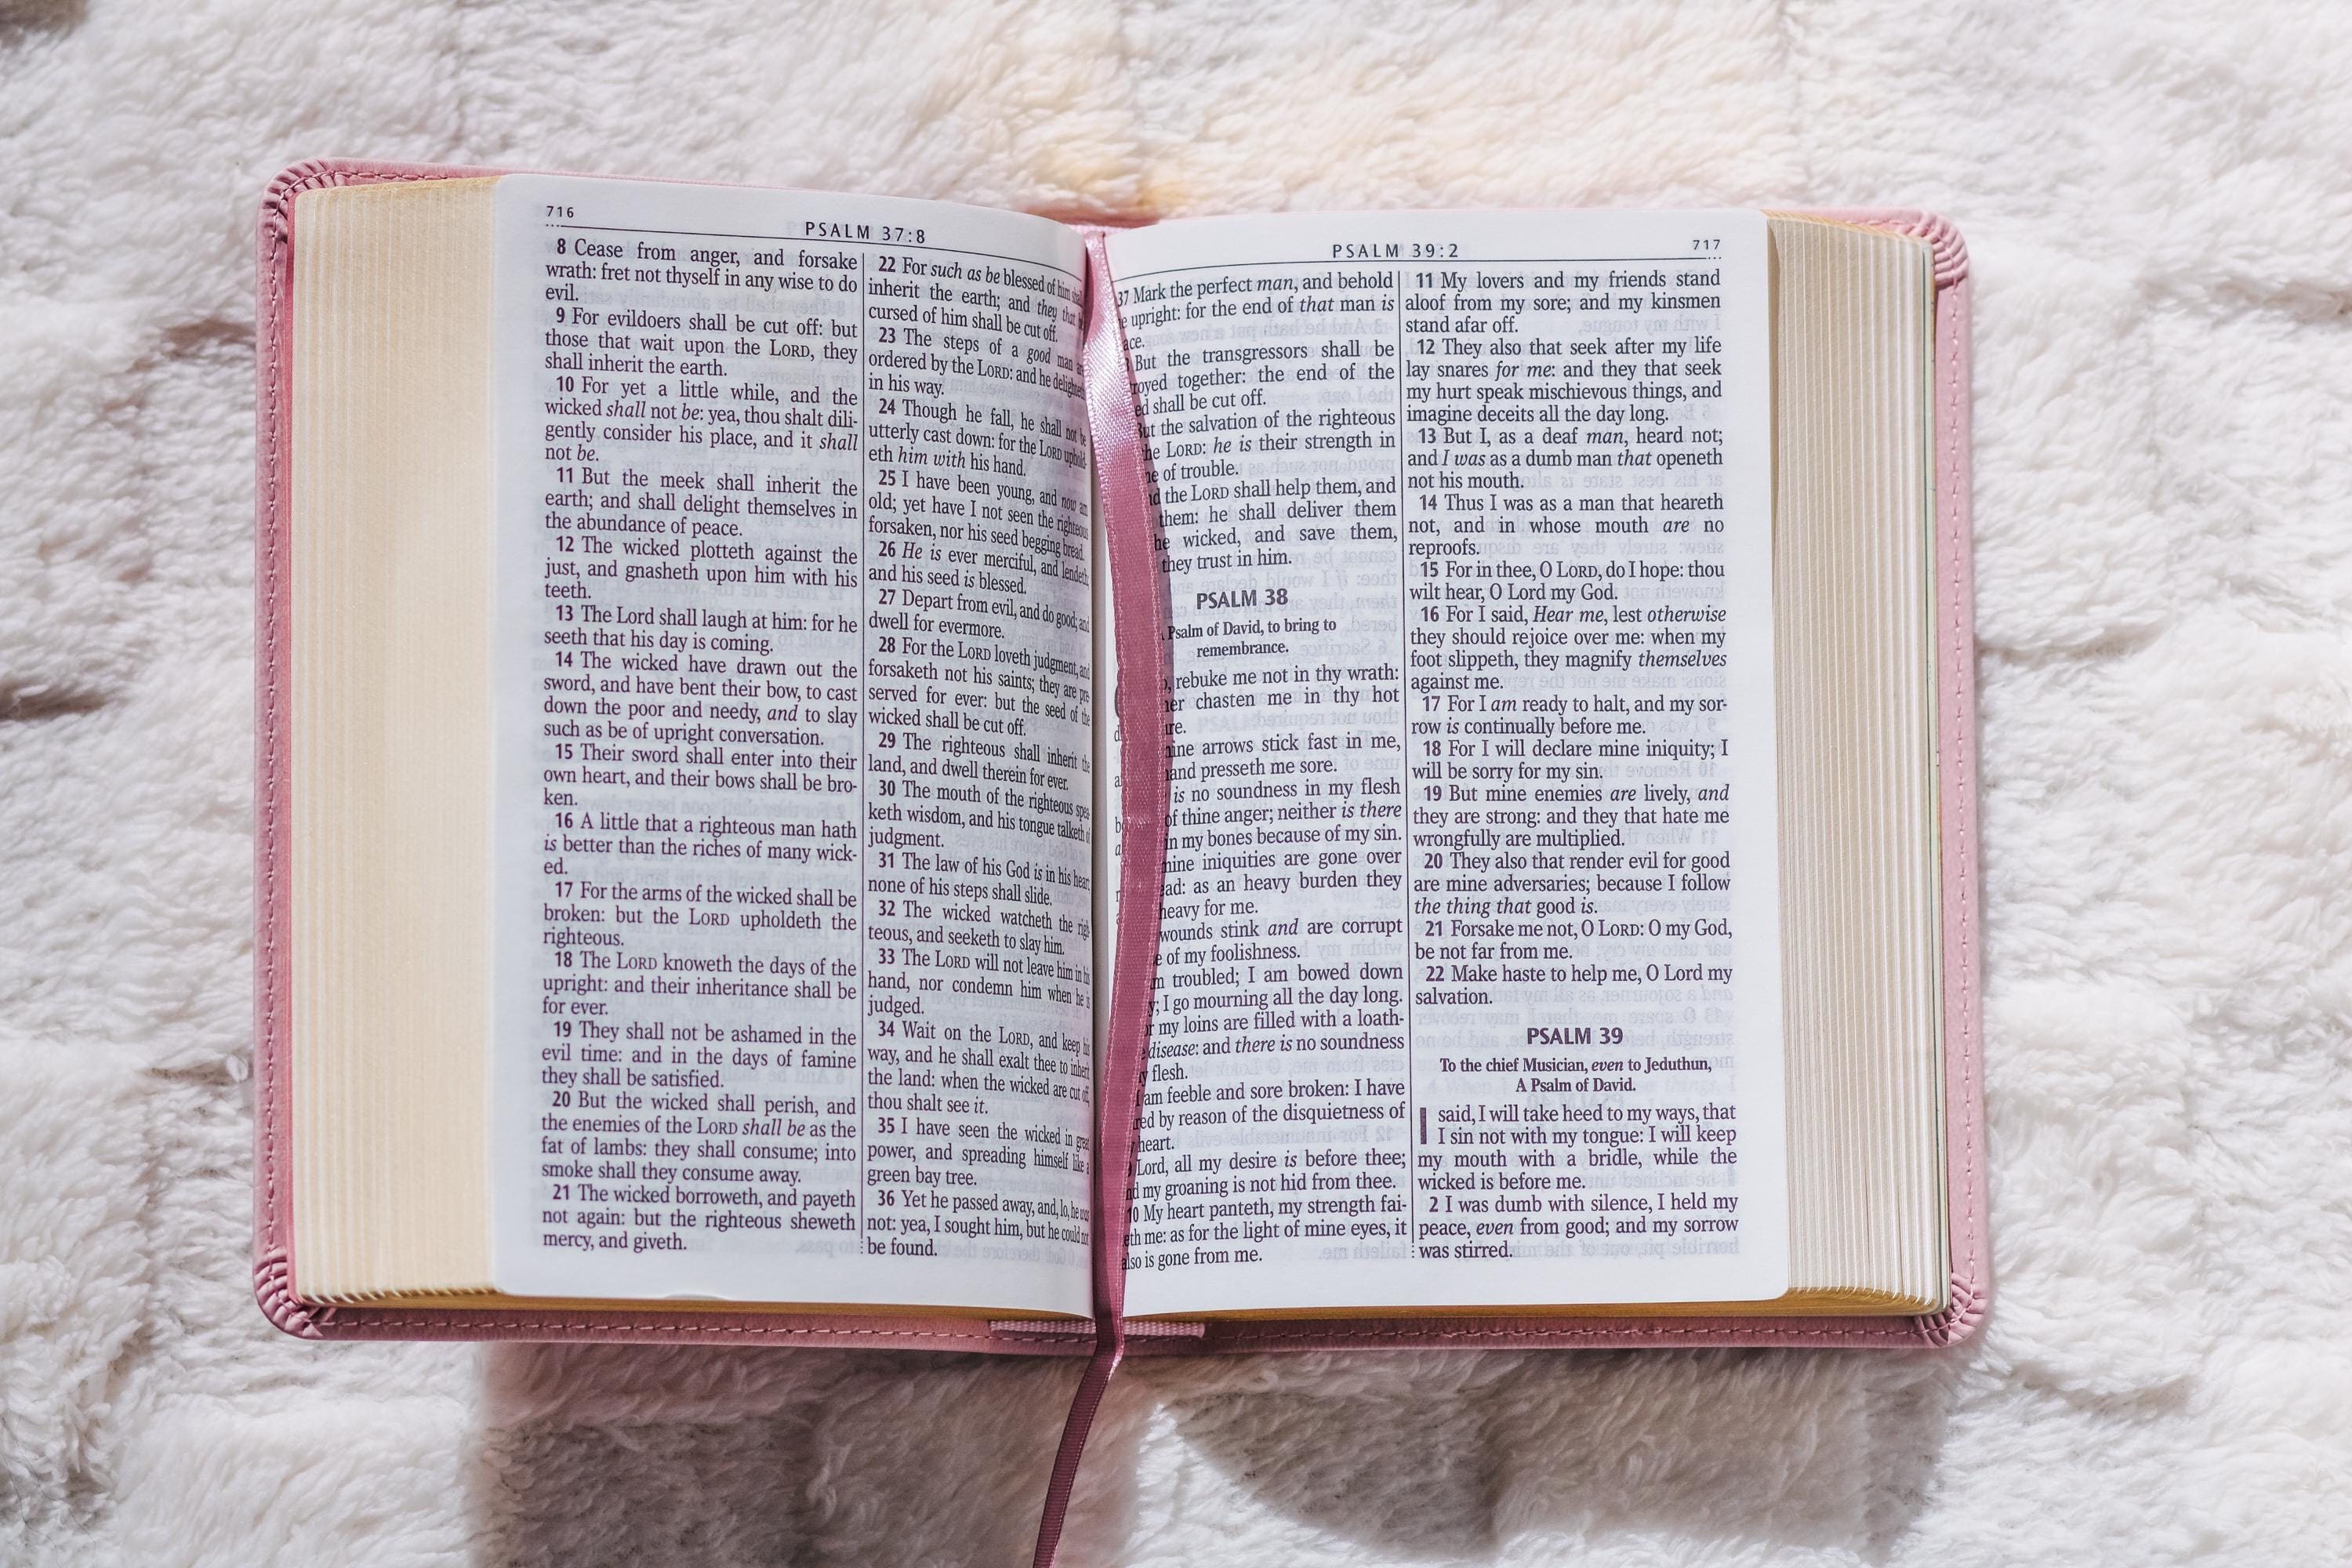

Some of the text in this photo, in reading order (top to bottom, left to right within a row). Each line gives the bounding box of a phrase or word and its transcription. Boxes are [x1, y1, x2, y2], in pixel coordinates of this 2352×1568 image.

[546, 205, 574, 219] 716
[805, 221, 926, 244] PSALM 37:8
[1693, 239, 1720, 250] 717
[557, 238, 858, 270] 8 Cease from anger, and forsake
[1333, 243, 1458, 260] PSALM 39:2
[545, 260, 858, 293] wrath: fret not thyself in any wise to do
[1117, 270, 1394, 307] 37 Mark the perfect man, and behold
[1416, 268, 1721, 293] 11 My lovers and my friends stand
[868, 304, 1057, 343] cursed of him shall be cut off.
[1405, 315, 1519, 333] stand afar off.
[868, 372, 945, 399] in his way.
[1419, 492, 1724, 511] 14 Thus I was as a man that heareth
[556, 535, 858, 566] 12 The wicked plotteth against the
[1162, 547, 1292, 576] they trust in him.
[868, 564, 1027, 595] and his seed is blessed.
[1196, 588, 1289, 610] PSALM 38
[869, 610, 1005, 639] dwell for evermore.
[1167, 623, 1204, 641] Psalm
[1206, 621, 1220, 637] of
[1222, 619, 1265, 637] David,
[1267, 620, 1281, 633] to
[1283, 617, 1320, 635] bring
[1323, 619, 1337, 631] to
[1196, 641, 1289, 658] remembrance.
[868, 753, 1069, 791] land, and dwell therein for ever.
[1412, 828, 1625, 851] wrongfully are multiplied.
[1159, 898, 1258, 921] heavy for me.
[1159, 917, 1403, 942] wounds stink and are corrupt
[1526, 1026, 1624, 1045] PSALM 39
[1439, 1056, 1712, 1075] To the chief Musician, even to Jeduthun,
[1515, 1076, 1636, 1093] A Psalm of David.
[867, 1091, 989, 1115] thou shalt see it.
[552, 1183, 856, 1211] 21 The wicked borroweth, and payeth
[1127, 1194, 1407, 1225] 10 My heart panteth, my strength fai-
[1418, 1215, 1739, 1240] peace, even from good; and my sorrow
[543, 1231, 687, 1254] mercy, and giveth.
[866, 1236, 938, 1257] be found.
[1418, 1240, 1513, 1259] was stirred.
[1121, 1246, 1262, 1272] also is gone from me.
